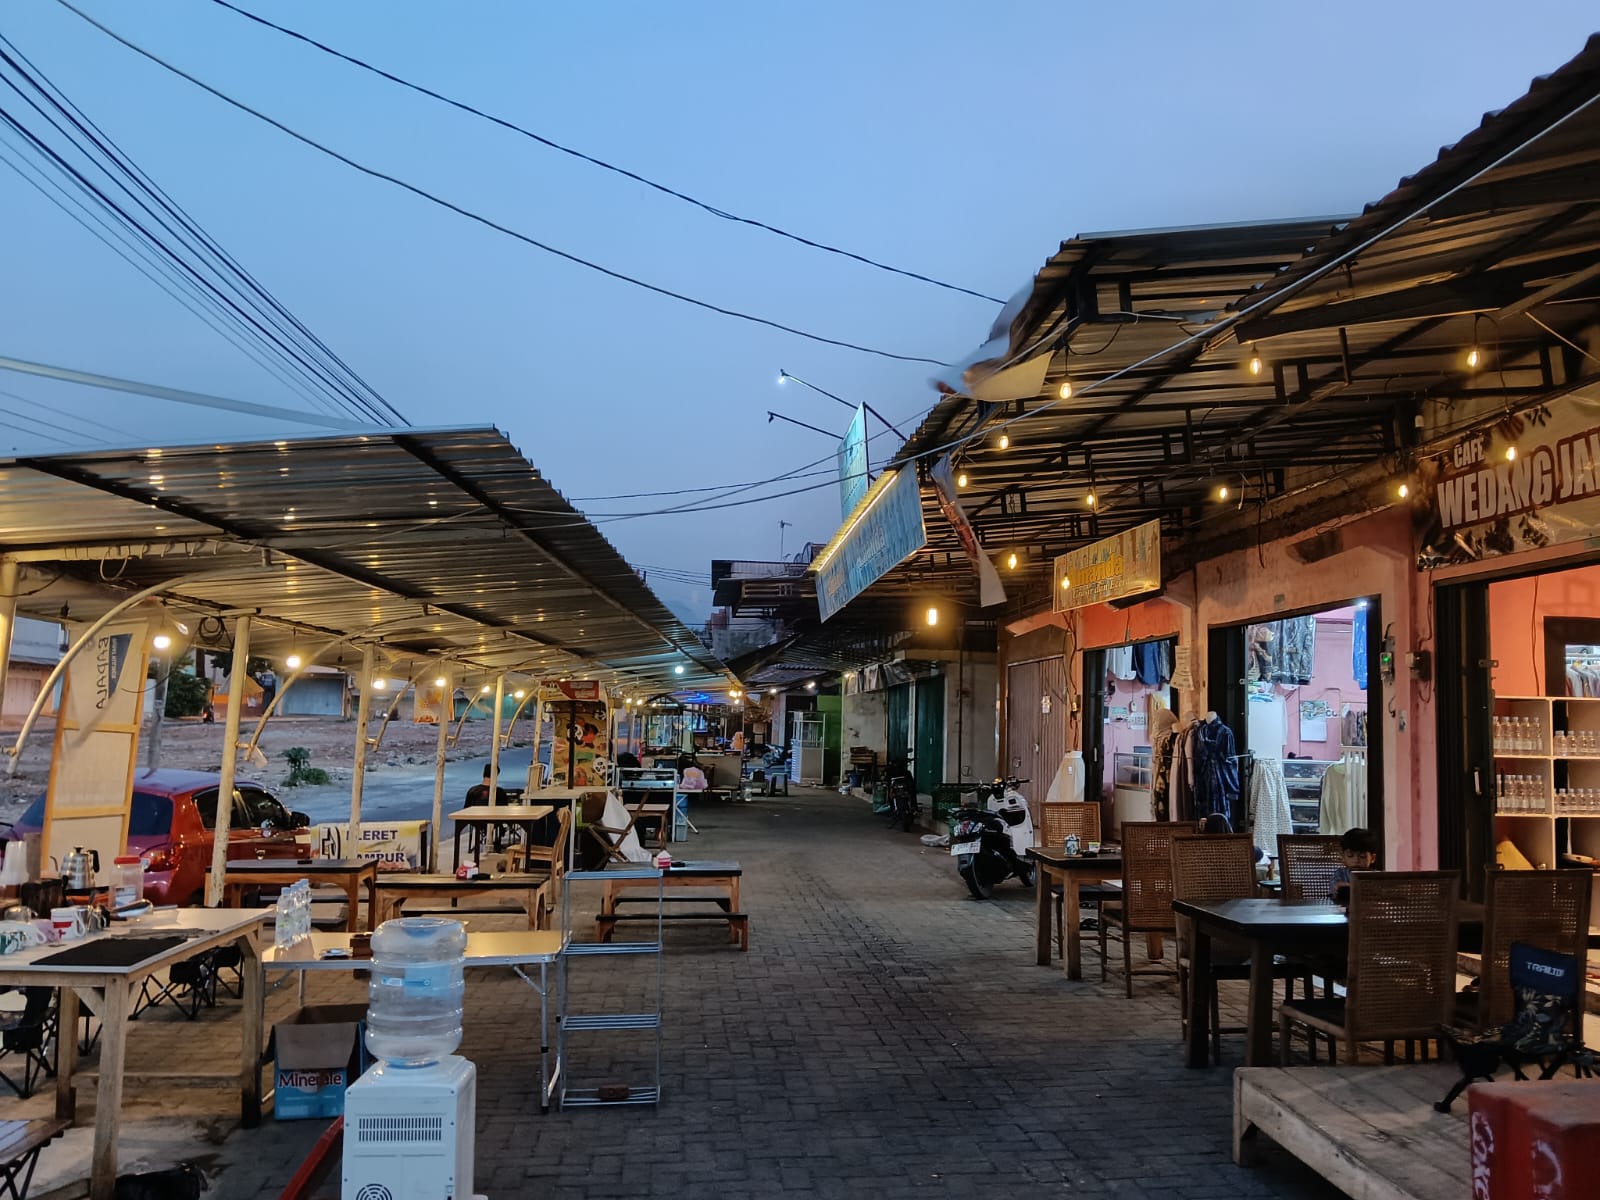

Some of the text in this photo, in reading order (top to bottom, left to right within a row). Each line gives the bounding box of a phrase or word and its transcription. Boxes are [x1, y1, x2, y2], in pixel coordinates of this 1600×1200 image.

[1453, 437, 1485, 469] CAFE
[1436, 450, 1553, 529] WEDANG
[345, 852, 405, 863] AMPUR
